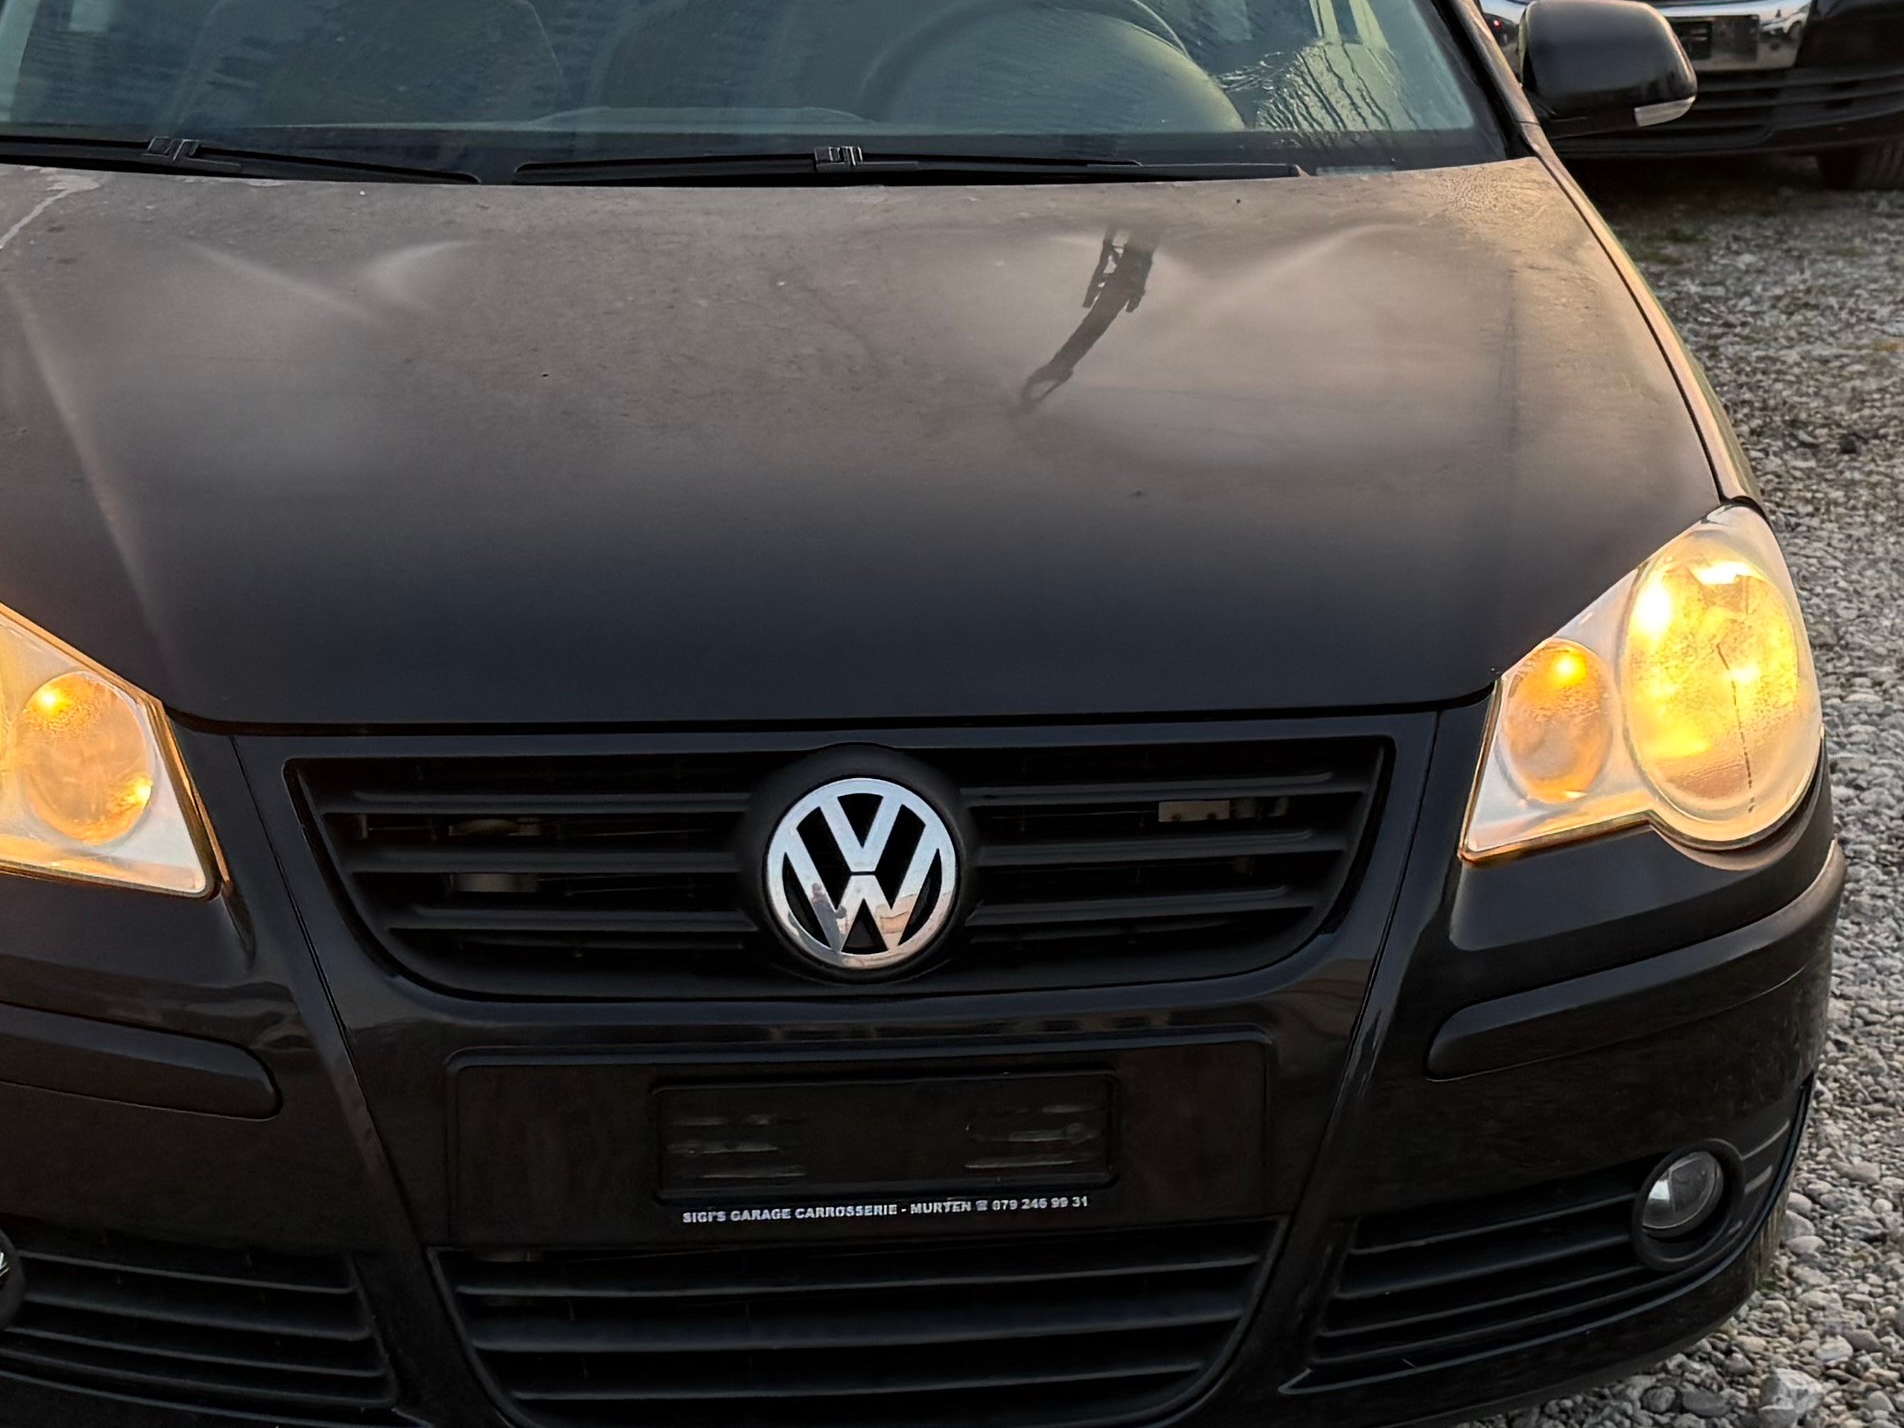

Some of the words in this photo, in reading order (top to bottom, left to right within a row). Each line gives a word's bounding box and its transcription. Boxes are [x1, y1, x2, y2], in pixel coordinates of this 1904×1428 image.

[730, 1208, 791, 1221] GARAGE
[794, 1204, 898, 1219] CARROSSERIE
[910, 1200, 972, 1215] MURTEN
[991, 1199, 1018, 1211] 079
[1071, 1195, 1088, 1208] 31
